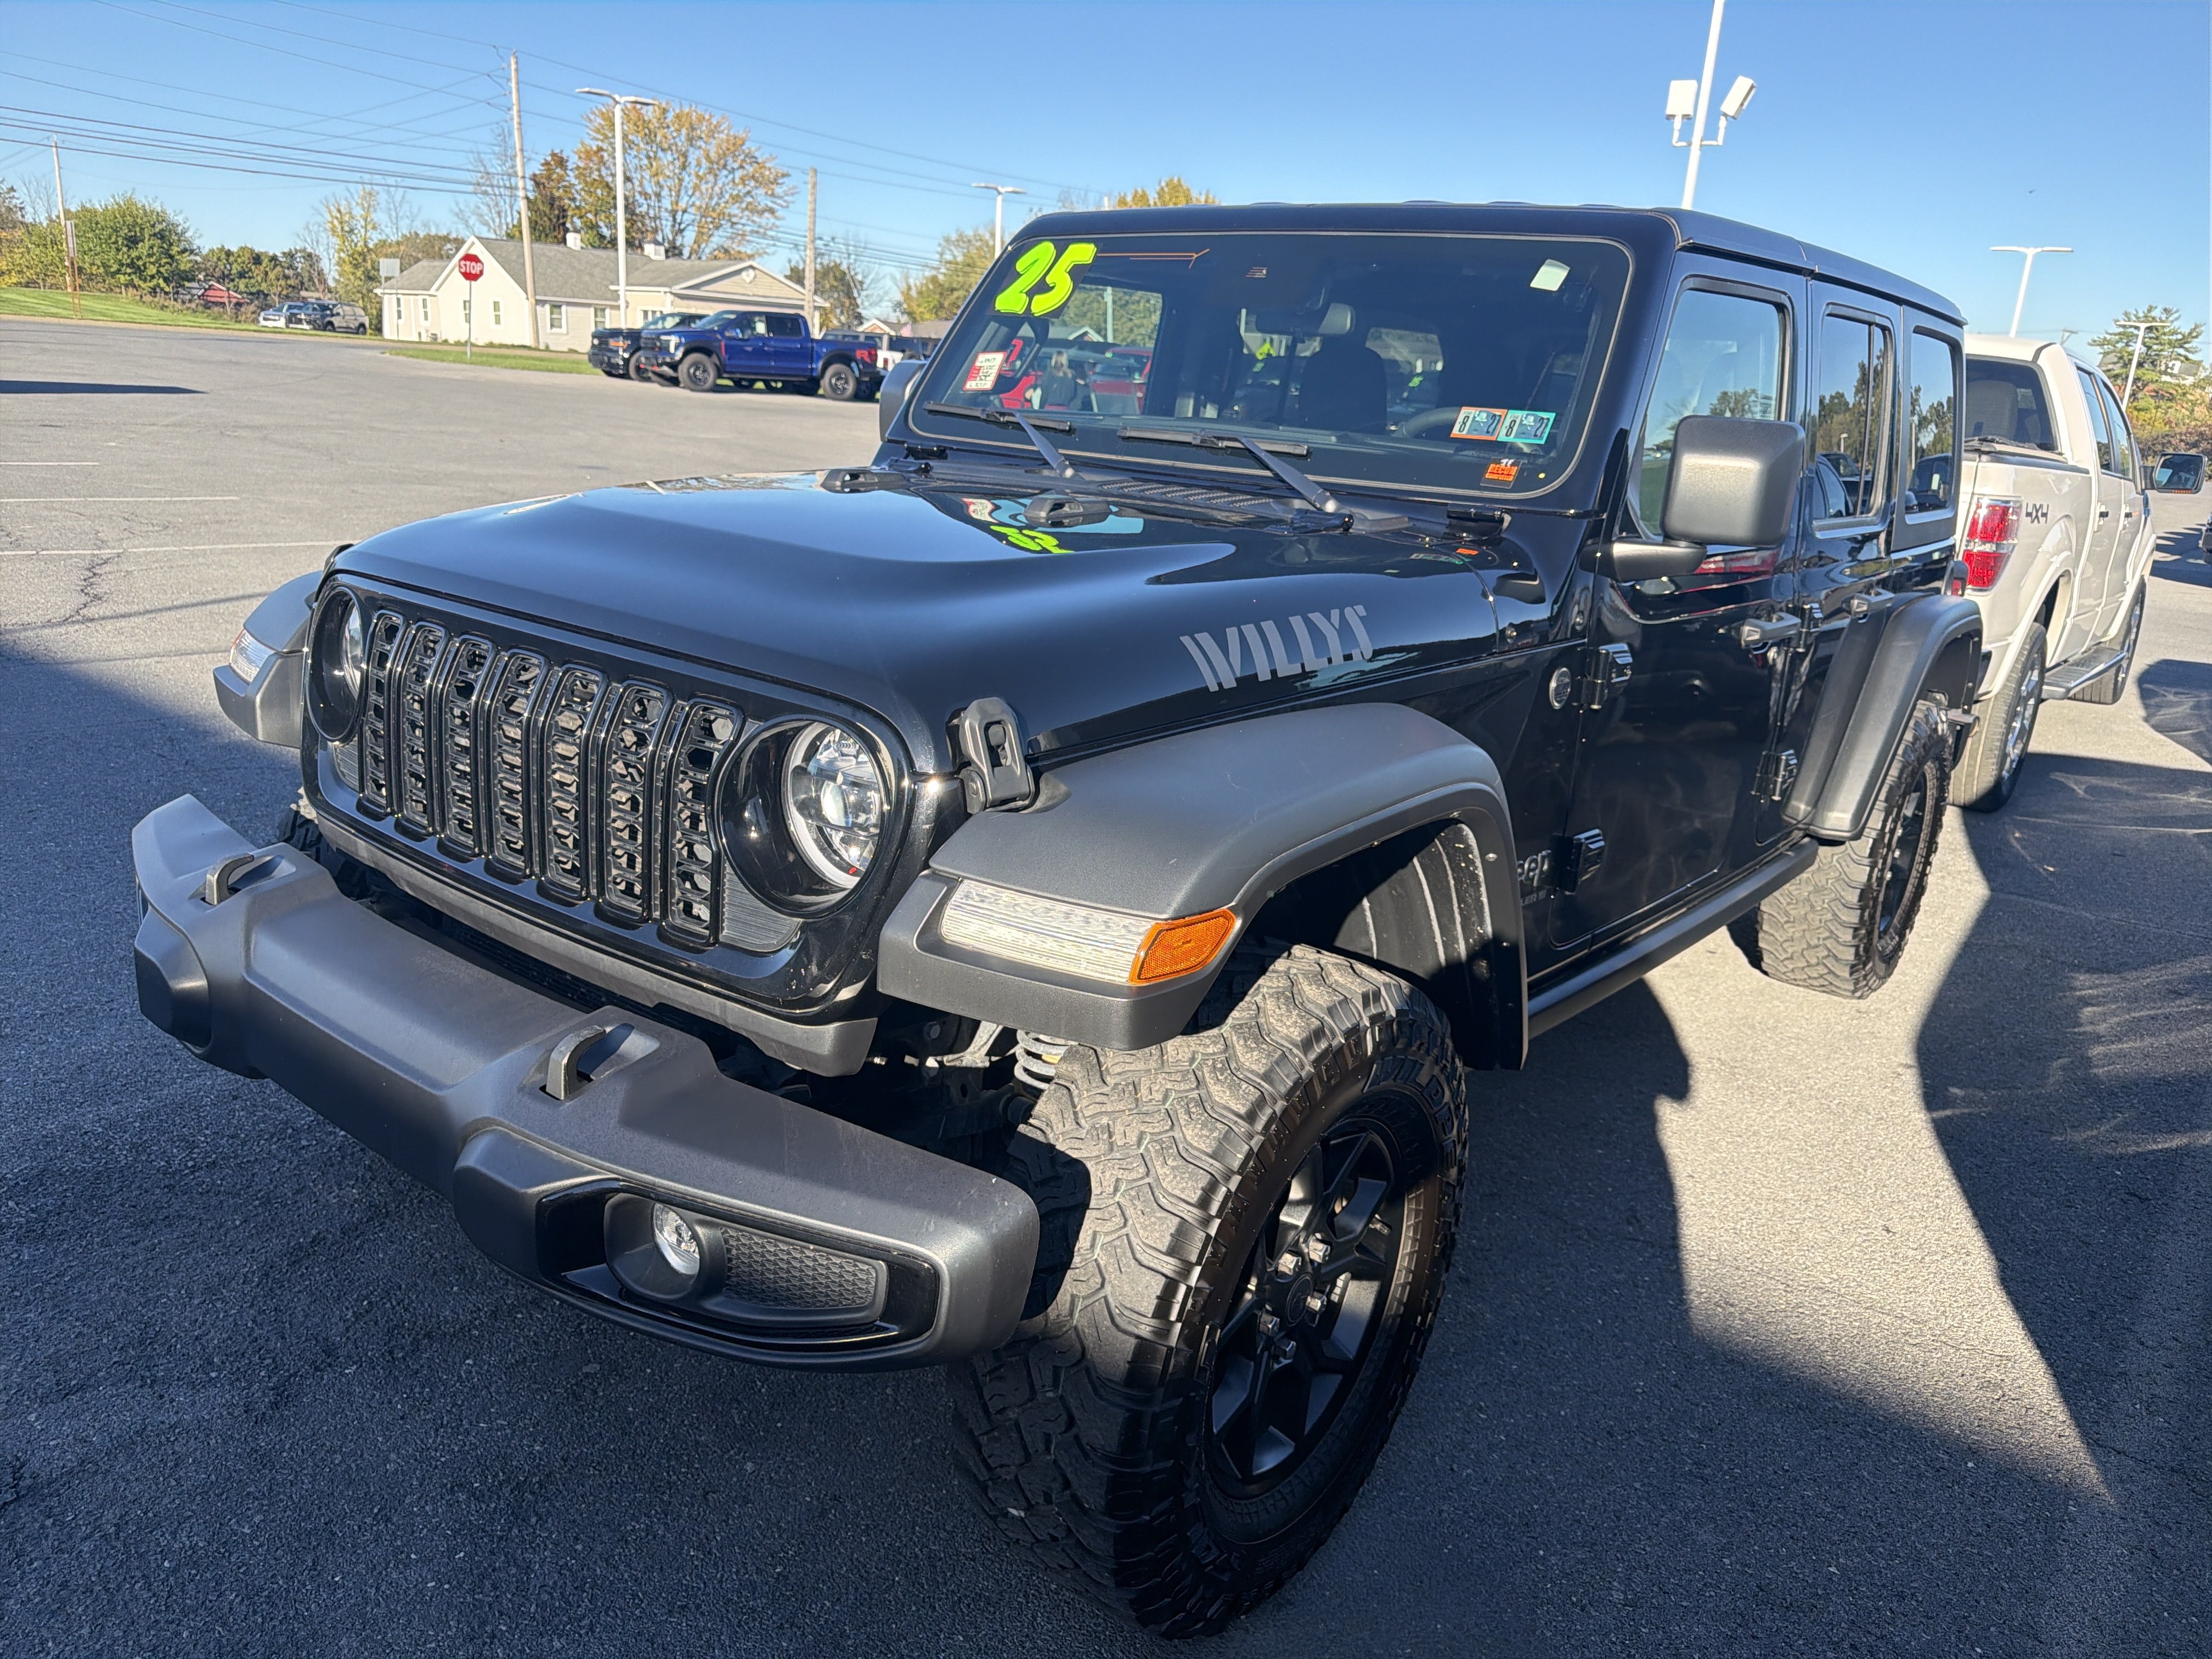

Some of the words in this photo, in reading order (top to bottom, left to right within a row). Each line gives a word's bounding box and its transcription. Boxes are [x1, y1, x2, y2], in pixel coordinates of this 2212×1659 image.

[460, 259, 483, 275] STOP
[994, 240, 1097, 317] 25
[1458, 415, 1470, 433] 8
[1486, 414, 1502, 434] 27
[1505, 419, 1517, 437] 8
[1533, 417, 1550, 438] 27
[1179, 605, 1373, 692] WILLYS
